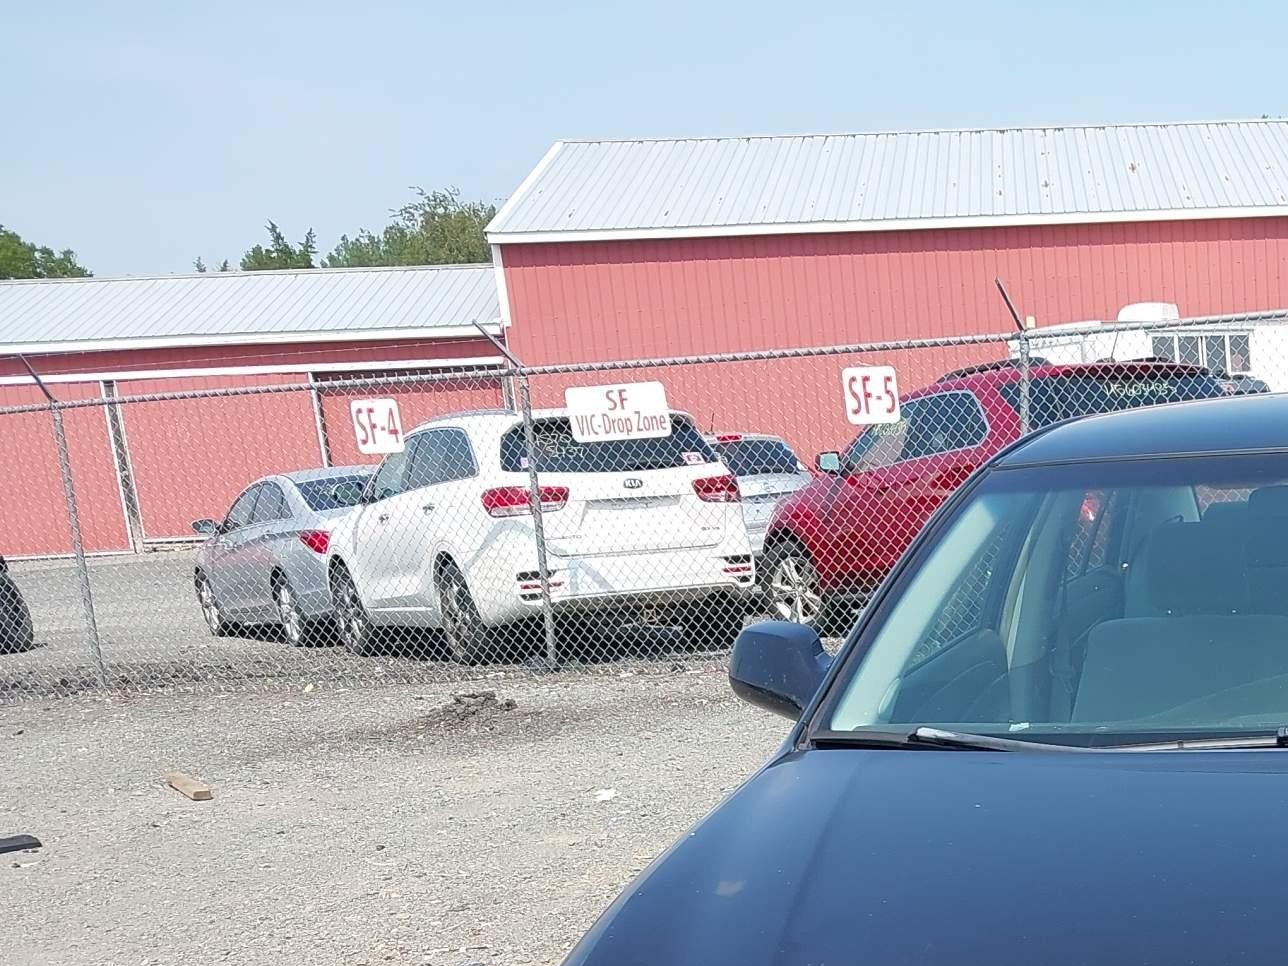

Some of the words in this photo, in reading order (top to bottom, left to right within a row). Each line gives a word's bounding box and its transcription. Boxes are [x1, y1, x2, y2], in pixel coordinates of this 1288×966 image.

[604, 389, 629, 411] SF
[850, 375, 896, 416] SF-5
[354, 407, 399, 446] SF-4
[575, 412, 633, 437] VIC-Drop
[636, 410, 667, 433] Zone
[624, 478, 643, 489] KIA
